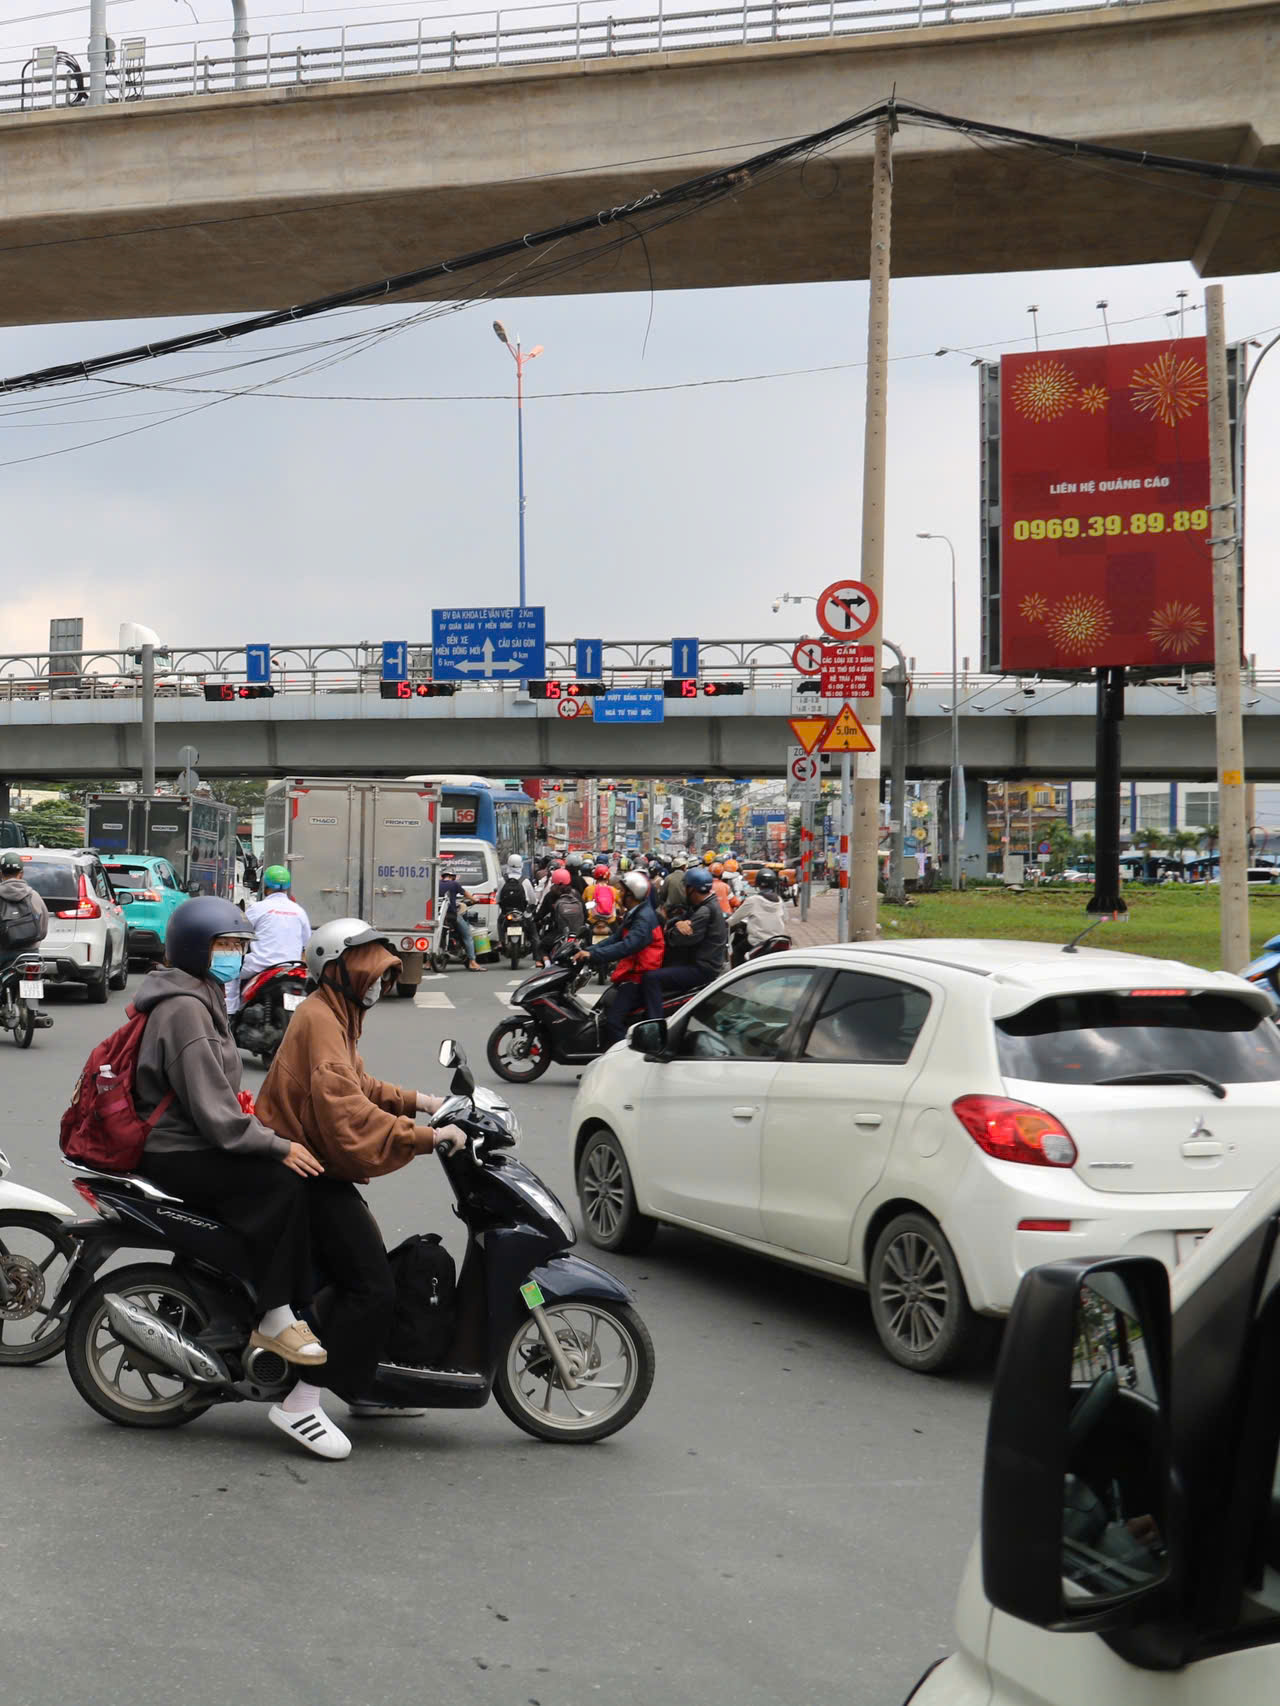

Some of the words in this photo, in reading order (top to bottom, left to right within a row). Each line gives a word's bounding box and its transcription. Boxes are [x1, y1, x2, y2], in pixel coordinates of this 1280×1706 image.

[1050, 481, 1077, 494] LIÊN
[1080, 480, 1096, 493] HỆ
[1099, 477, 1141, 492] QUẢNG
[1144, 475, 1170, 489] CÁO
[1013, 509, 1209, 541] 0969.39.89.89
[462, 610, 479, 619] KHOA
[460, 636, 469, 645] XE
[221, 684, 233, 701] 15
[397, 681, 412, 698] 15
[545, 681, 561, 698] 15
[681, 680, 697, 698] 15
[835, 725, 858, 736] 5.0m
[456, 809, 475, 823] 56
[377, 865, 430, 878] 60E-016.21
[156, 1207, 219, 1230] VISION
